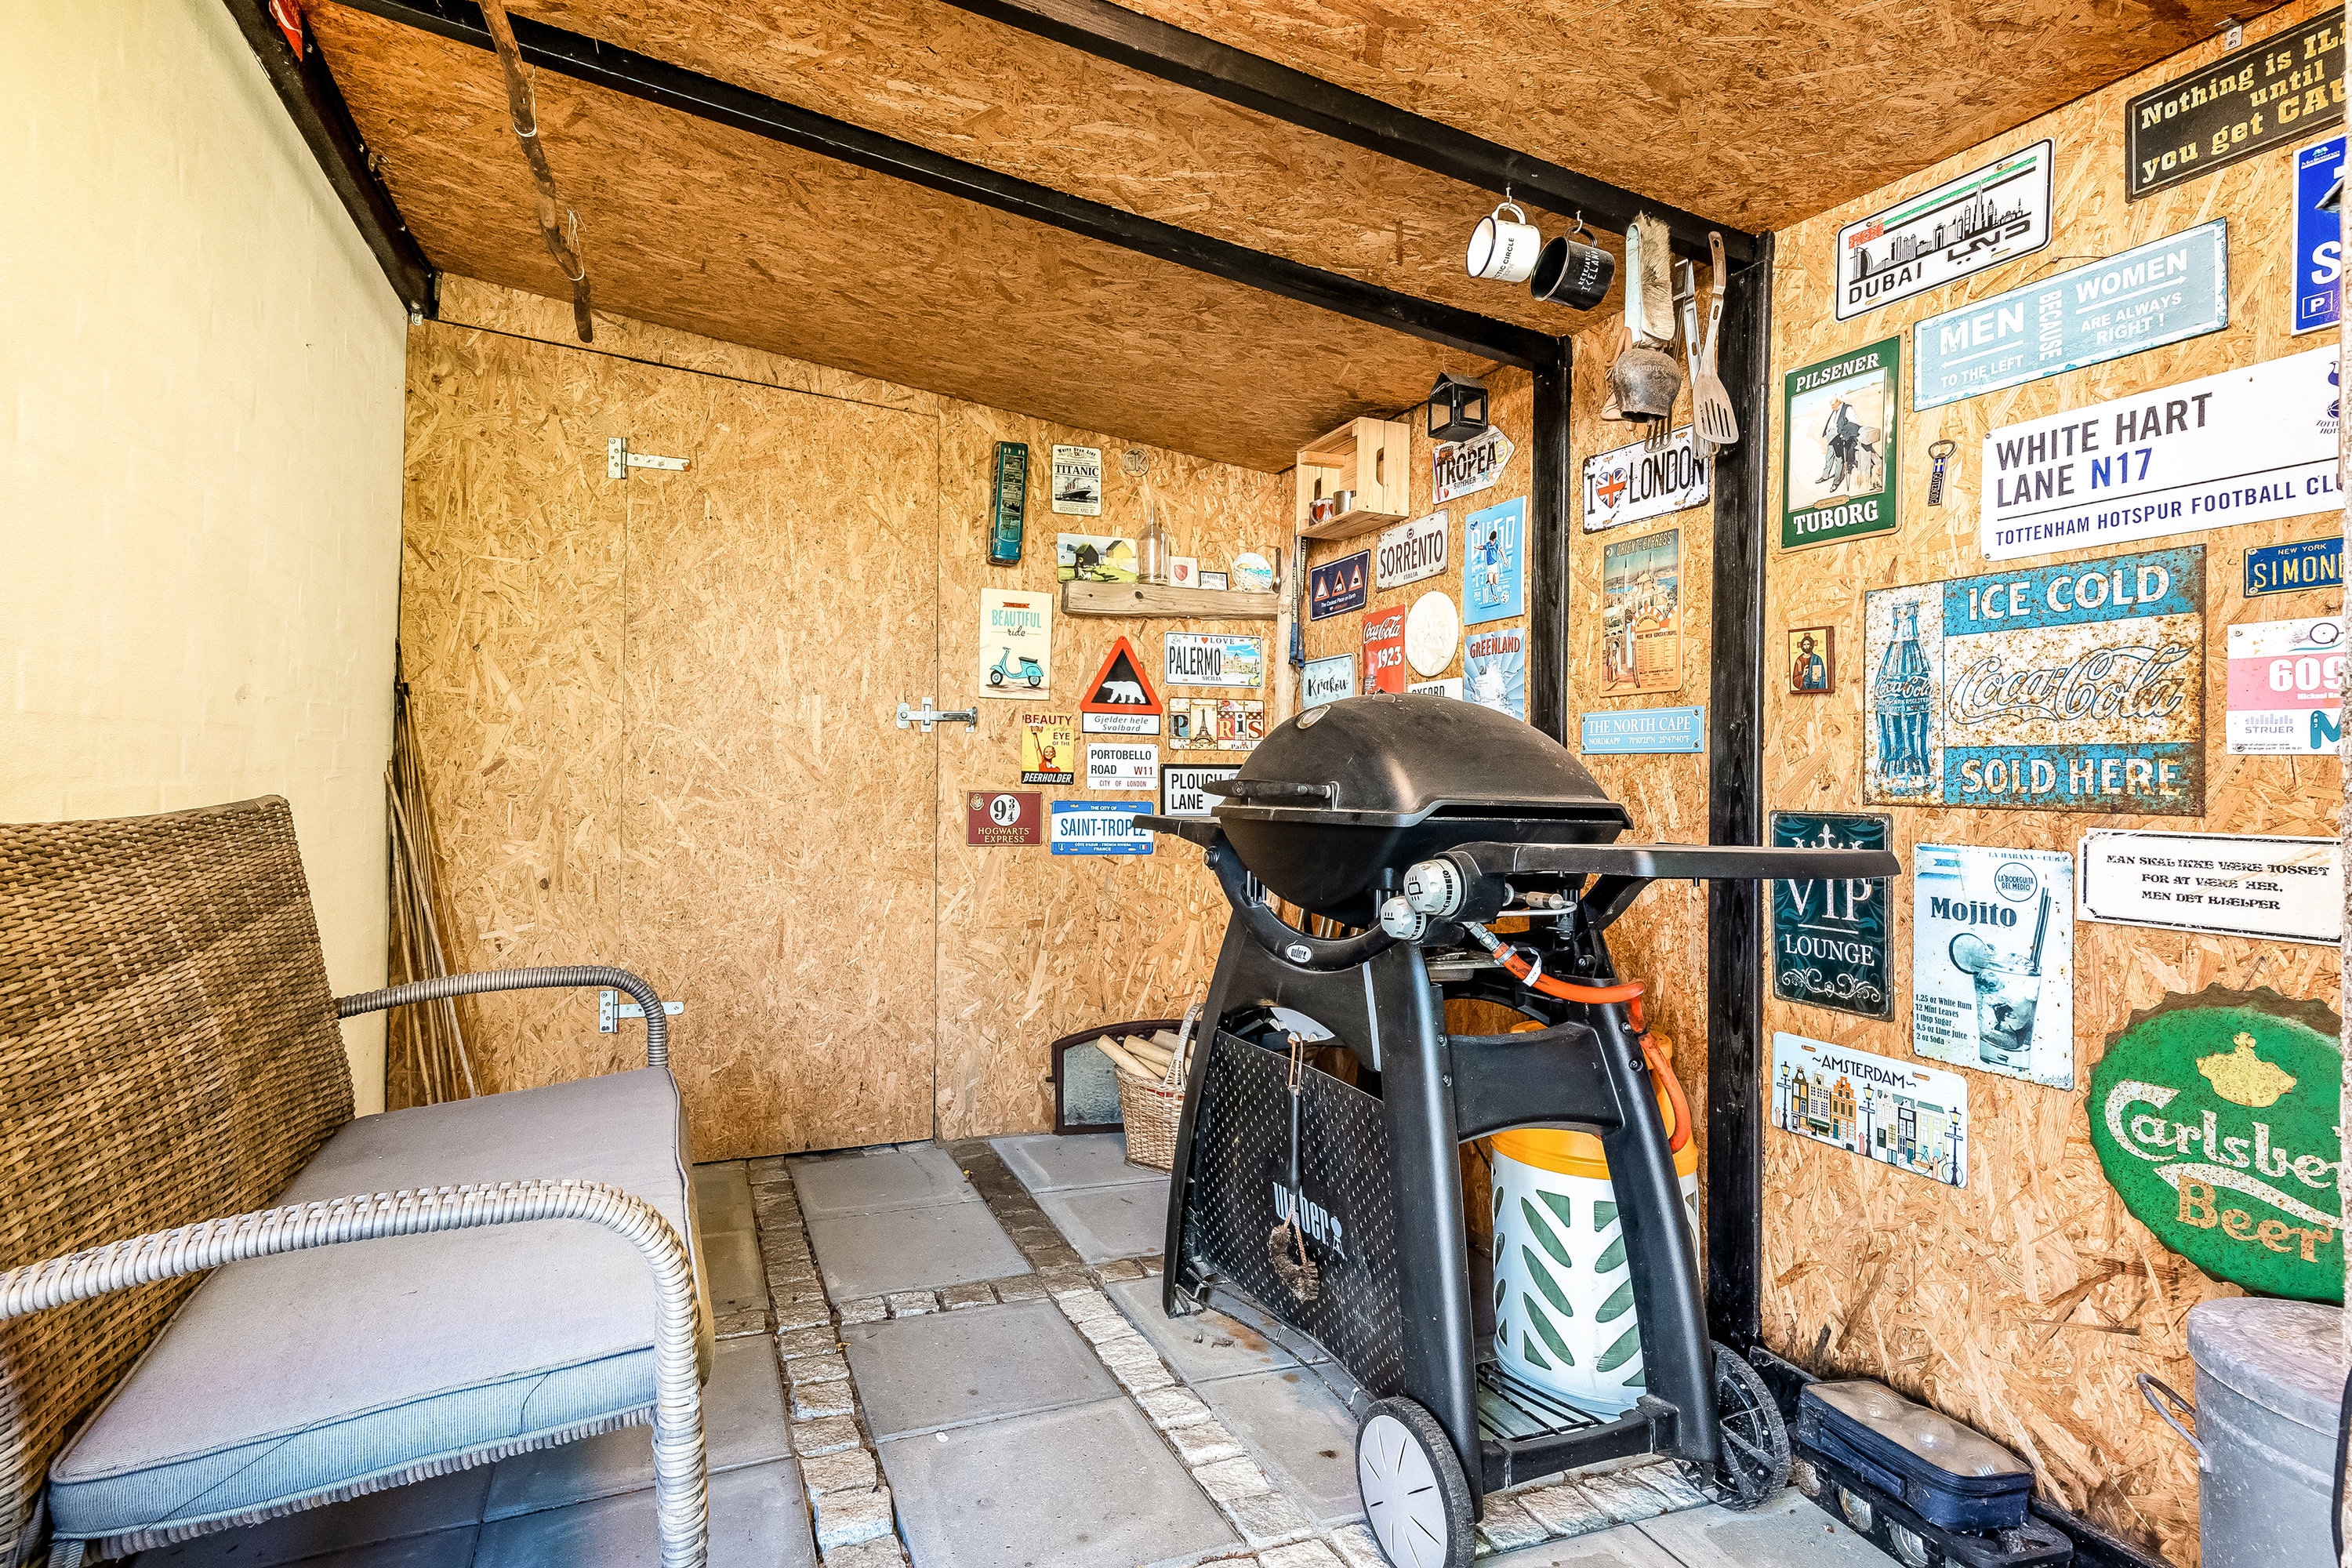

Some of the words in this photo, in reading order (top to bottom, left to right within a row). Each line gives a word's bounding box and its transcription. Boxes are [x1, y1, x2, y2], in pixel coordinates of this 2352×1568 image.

[2141, 63, 2255, 129] Nothing
[2265, 50, 2292, 76] is
[2304, 21, 2346, 60] IL
[2250, 60, 2325, 107] until
[2142, 142, 2198, 183] you
[2211, 112, 2263, 155] get
[1503, 238, 1514, 264] CIRCLE
[1947, 219, 2031, 265] دبي
[1849, 262, 1922, 304] DUBAI
[2075, 248, 2188, 304] WOMEN
[2080, 314, 2112, 332] ARE
[2116, 292, 2183, 323] ALWAYS
[2310, 297, 2325, 313] P
[1940, 302, 2024, 356] MEN
[2039, 289, 2063, 361] BECAUSE
[2096, 318, 2151, 345] RIGHT
[1795, 352, 1880, 393] PILSENER
[1940, 374, 1958, 389] TO
[1960, 364, 1987, 383] THE
[1991, 354, 2024, 376] LEFT
[1995, 419, 2099, 470] WHITE
[2117, 393, 2212, 445] HART
[1054, 464, 1099, 476] TITANIC
[1436, 441, 1497, 488] TROPEA
[1998, 463, 2074, 508] LANE
[2092, 448, 2152, 490] N17
[1587, 474, 1595, 515] I
[1629, 446, 1704, 504] LONDON
[1793, 500, 1878, 535] TUBORG
[1995, 516, 2089, 546] TOTTENHAM
[2097, 501, 2182, 529] HOTSPUR
[2191, 481, 2296, 515] FOOTBALL
[1380, 530, 1443, 579] SORRENTO
[2278, 547, 2298, 556] NEW
[2302, 543, 2327, 552] YORK
[1403, 572, 1418, 580] ITALIA
[1969, 580, 2031, 621] ICE
[2046, 566, 2170, 612] COLD
[992, 609, 1041, 628] BEAUTIFUL
[1007, 625, 1025, 637] ride
[1169, 646, 1221, 676] PALERMO
[1377, 646, 1402, 669] 1923
[1469, 637, 1520, 658] GREENLAND
[1025, 714, 1073, 725] BEAUTY
[1094, 716, 1127, 724] Gjelder
[1588, 720, 1610, 733] THE
[1613, 717, 1655, 733] NORTH
[1659, 716, 1691, 731] CAPE
[1091, 750, 1152, 760] PORTOBELLO
[1091, 765, 1116, 775] ROAD
[1134, 766, 1152, 775] W11
[1961, 759, 2055, 794] SOLD
[2069, 760, 2182, 795] HERE
[1171, 794, 1203, 809] LANE
[2005, 875, 2034, 884] BODEGUITA
[2107, 855, 2136, 865] MAN
[2140, 857, 2176, 867] SKAL
[2178, 858, 2214, 869] IKKE
[2218, 861, 2263, 873] VÆRE
[2267, 864, 2329, 877] TOSSET
[2142, 873, 2169, 884] FOR
[2173, 876, 2190, 885] AT
[2195, 877, 2238, 888] VÆRE
[2245, 880, 2283, 893] HER,
[1788, 878, 1872, 921] VIP
[1930, 896, 2016, 927] Mojito
[2142, 891, 2171, 901] MEN
[2176, 893, 2204, 904] DET
[2208, 895, 2281, 910] HJÆLPER
[1784, 934, 1875, 966] LOUNGE
[1924, 1005, 1936, 1014] Mint
[1938, 1007, 1958, 1018] Leaves
[1938, 997, 1956, 1007] White
[1957, 1000, 1972, 1010] Rum
[1921, 1014, 1933, 1024] tbsp
[1934, 1016, 1951, 1027] Sugar
[1935, 1026, 1951, 1036] Lime
[1951, 1029, 1967, 1040] Juice
[1930, 1036, 1944, 1045] Soda
[2176, 1174, 2333, 1263] Beer
